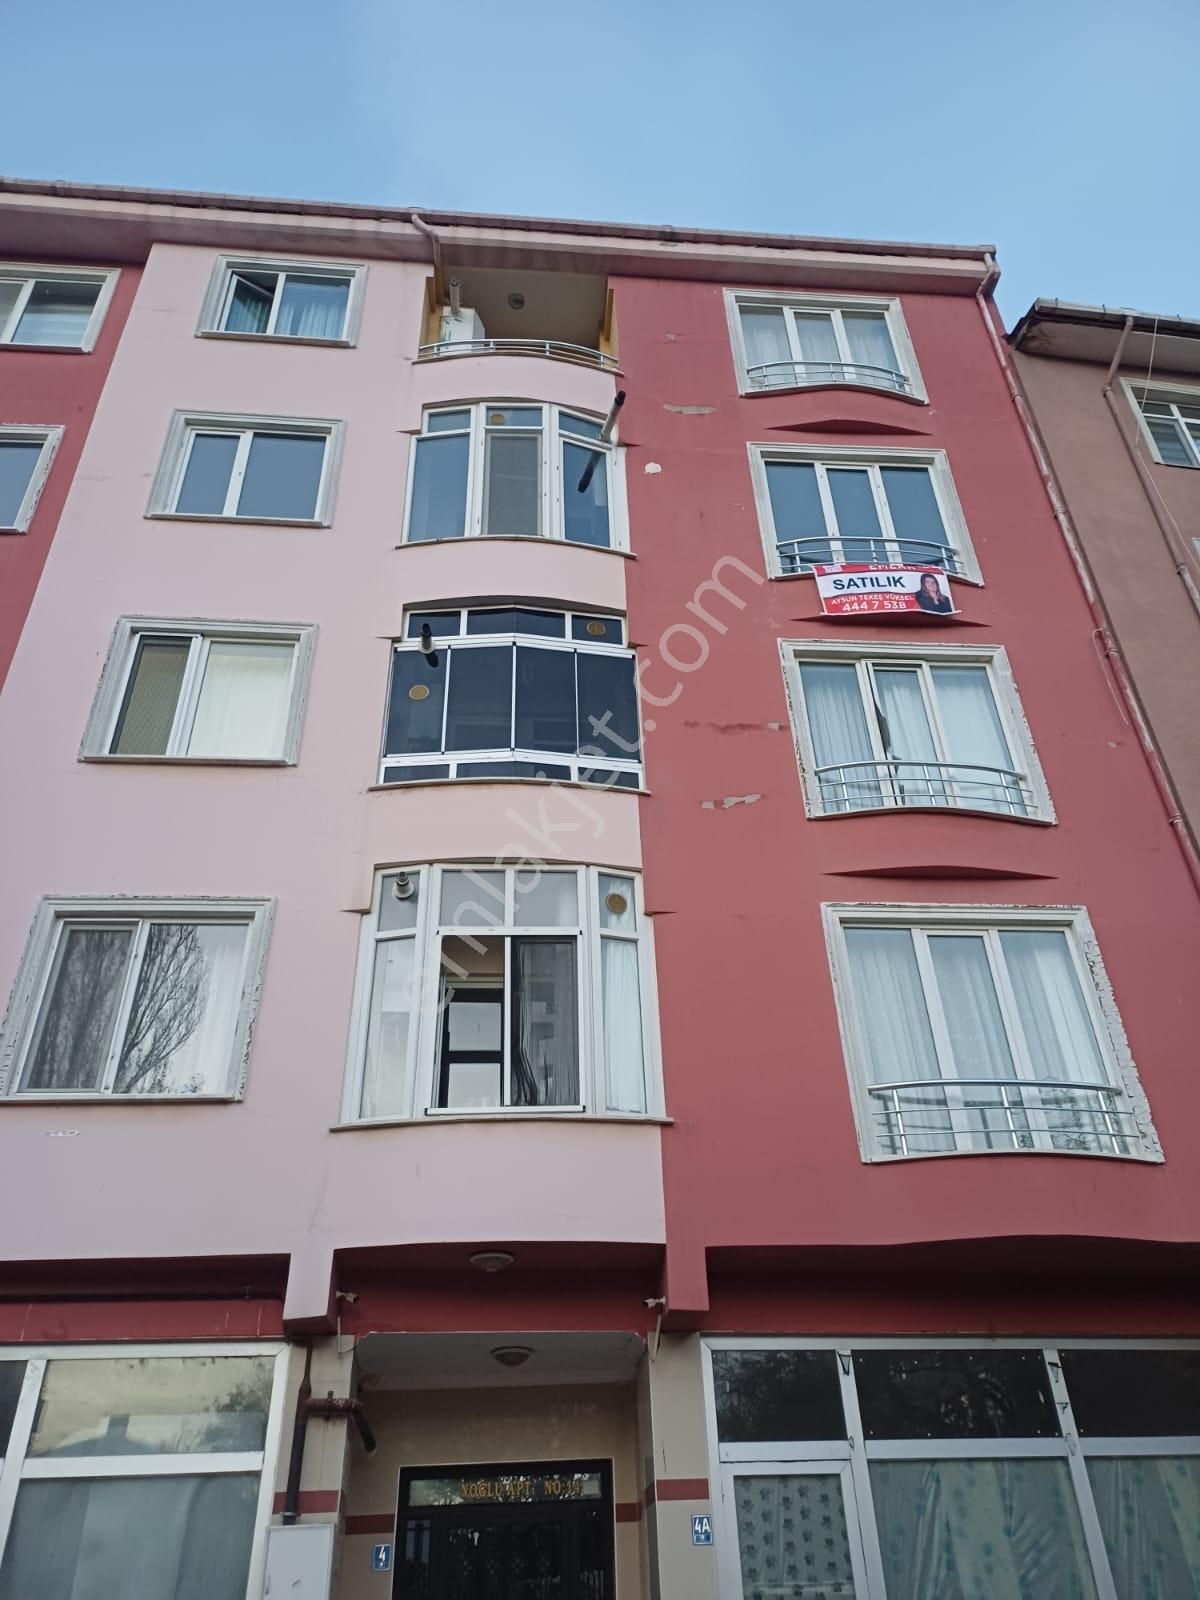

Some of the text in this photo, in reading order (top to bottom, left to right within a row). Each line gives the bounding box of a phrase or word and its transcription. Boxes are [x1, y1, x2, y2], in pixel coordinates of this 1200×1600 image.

[833, 576, 906, 590] SATILIK
[843, 601, 868, 611] 444
[872, 601, 880, 610] 7
[694, 1517, 711, 1533] 4A
